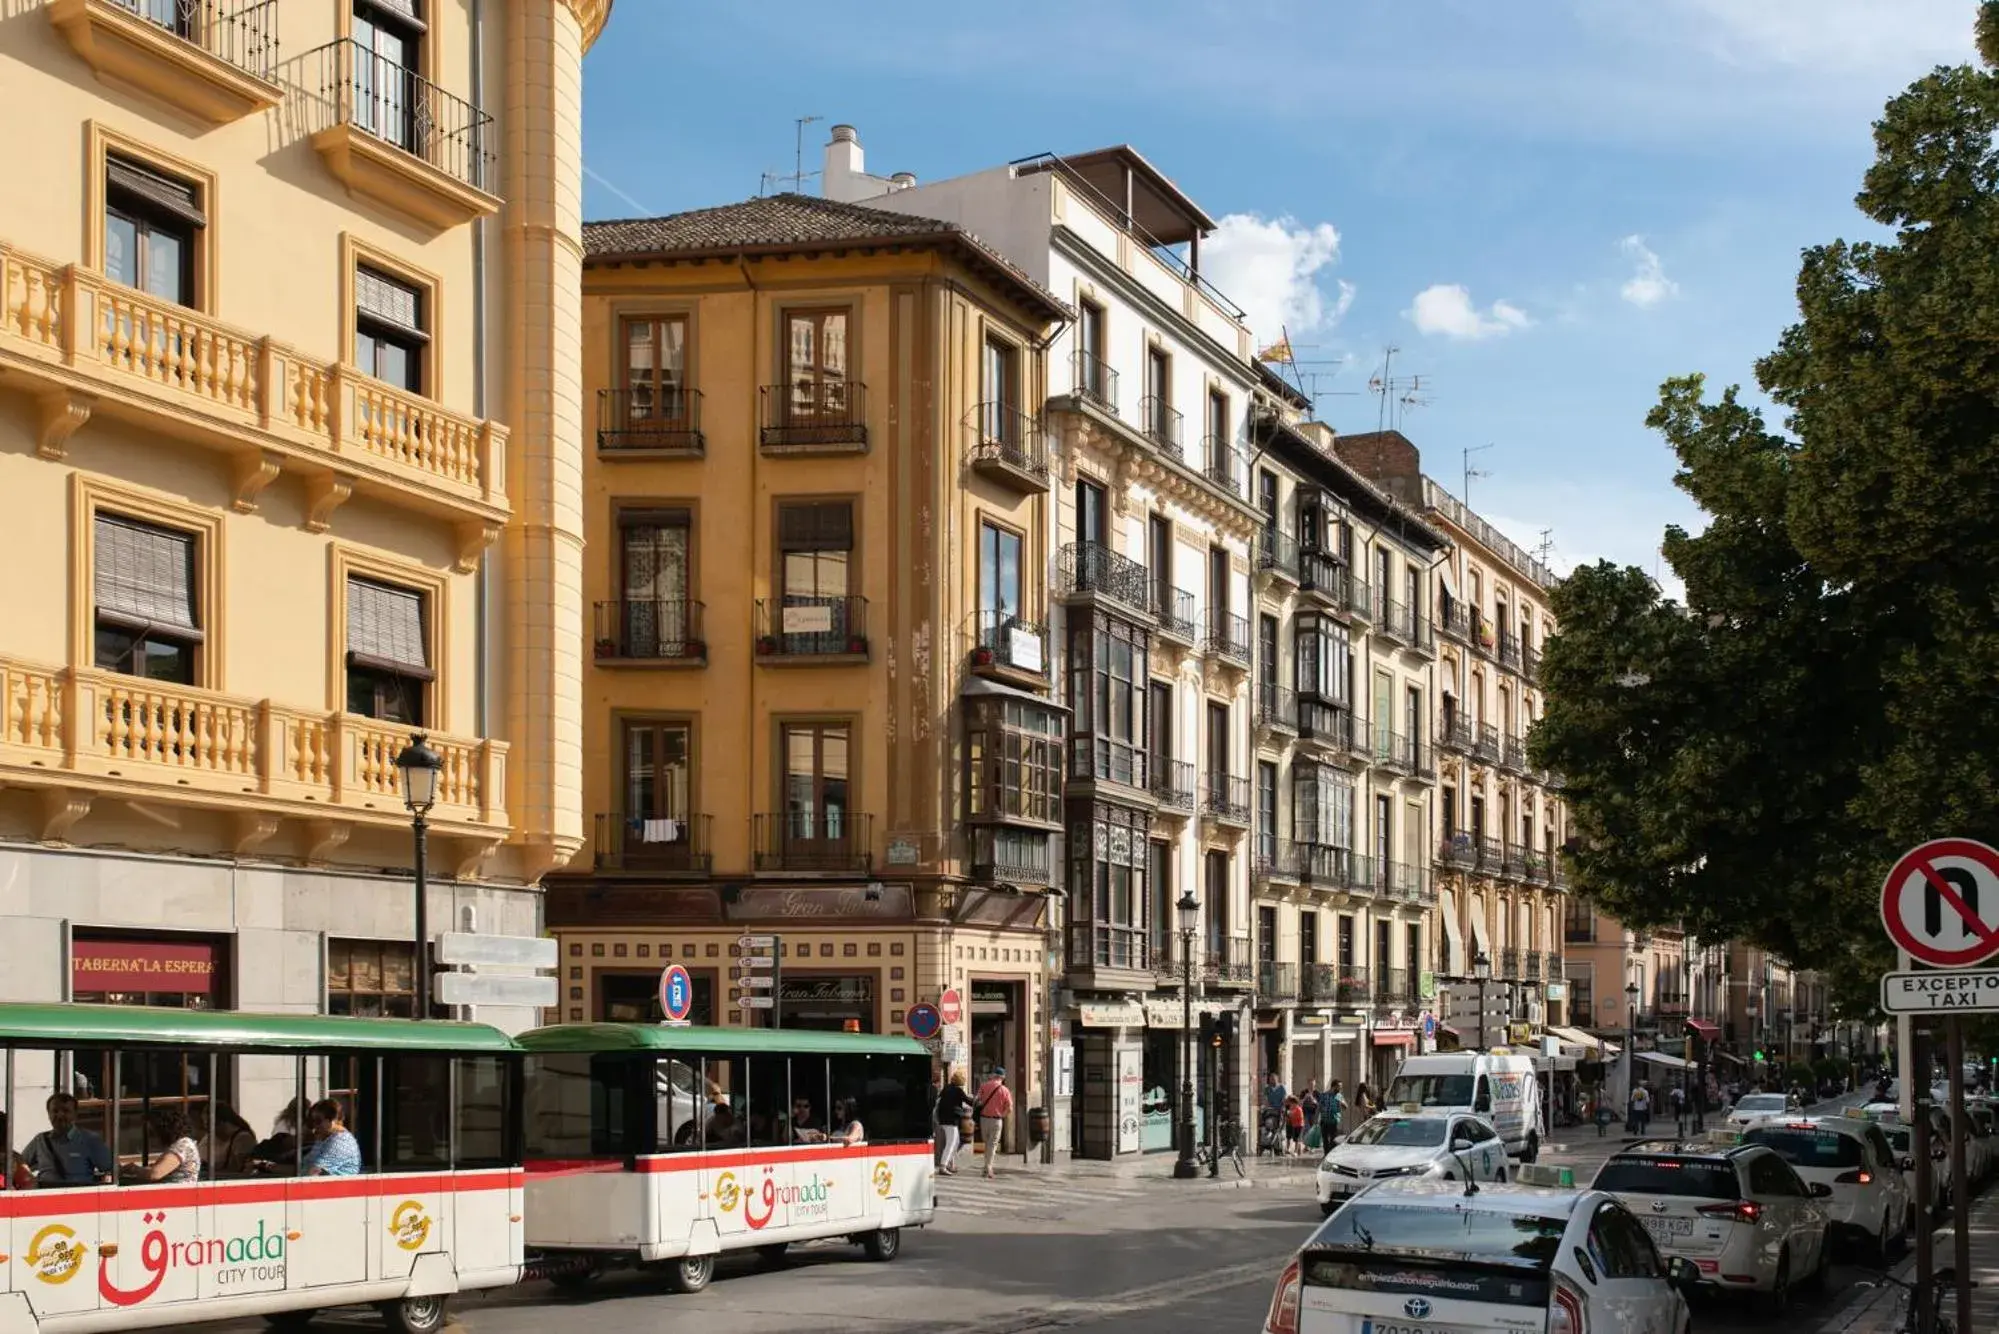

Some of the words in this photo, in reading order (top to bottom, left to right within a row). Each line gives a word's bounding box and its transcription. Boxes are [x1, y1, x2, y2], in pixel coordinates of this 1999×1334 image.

[73, 957, 140, 971] TABERNA
[1903, 976, 1999, 992] EXCEPTO
[1927, 992, 1976, 1006] TAXI
[217, 1268, 247, 1285] CITY
[251, 1264, 286, 1282] TOUR
